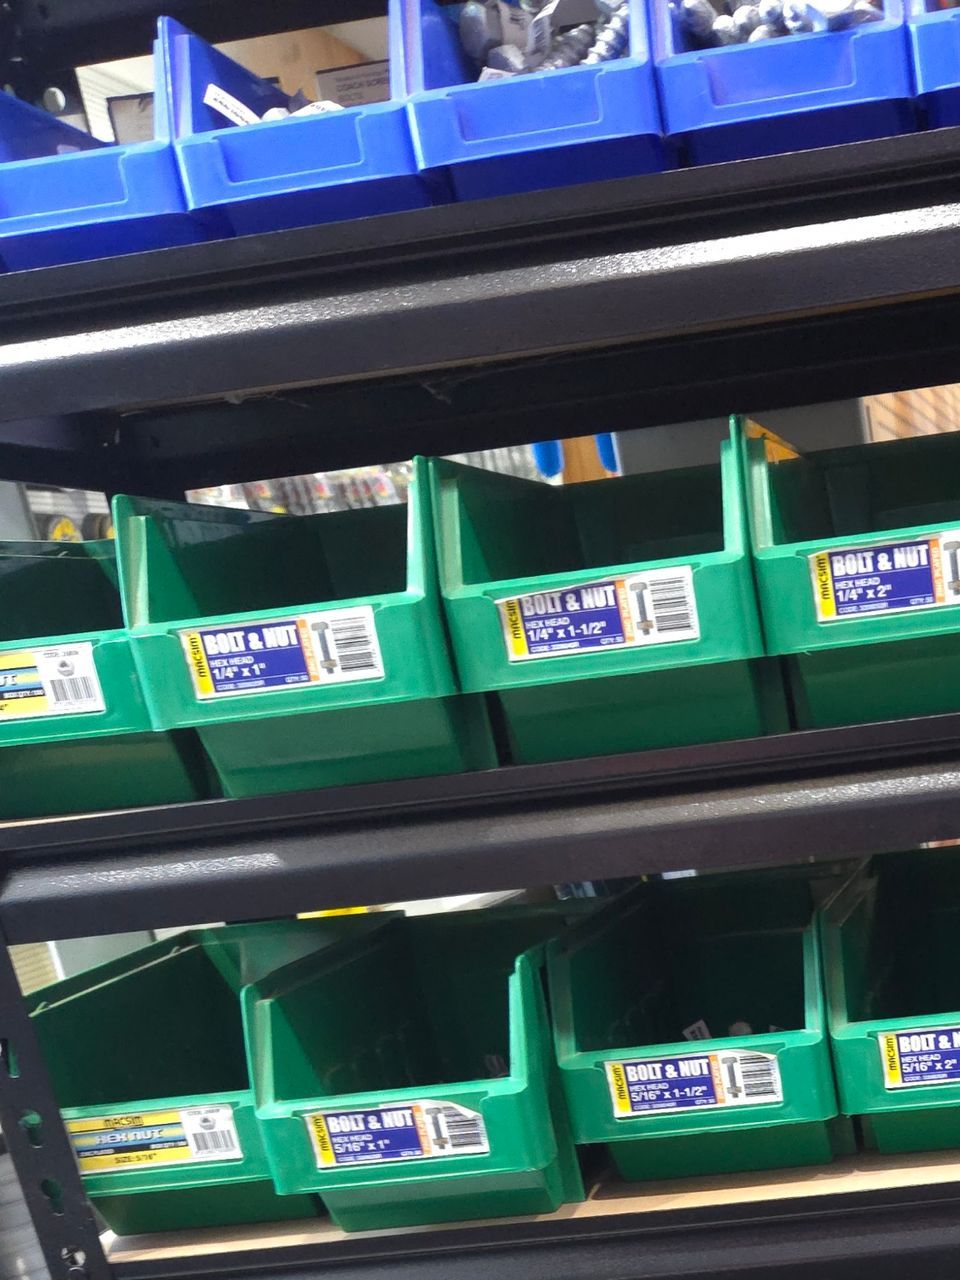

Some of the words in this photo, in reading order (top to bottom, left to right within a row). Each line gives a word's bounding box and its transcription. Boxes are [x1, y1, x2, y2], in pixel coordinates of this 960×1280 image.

[832, 551, 874, 576] BOLT
[877, 553, 892, 571] &
[894, 544, 929, 569] NUT
[522, 591, 566, 616] BOLT
[566, 594, 581, 611] &
[582, 585, 617, 609] NUT
[866, 589, 875, 599] x
[203, 631, 247, 655] BOLT
[247, 632, 264, 650] &
[262, 625, 298, 648] NUT
[556, 629, 566, 638] x
[241, 668, 251, 676] x
[899, 1034, 936, 1052] BOLT
[938, 1035, 951, 1049] &
[625, 1063, 662, 1082] BOLT
[665, 1064, 678, 1078] &
[678, 1059, 709, 1077] NUT
[663, 1089, 672, 1097] x
[327, 1114, 365, 1133] BOLT
[367, 1115, 382, 1129] &
[381, 1109, 414, 1128] NUT
[367, 1140, 375, 1149] x
